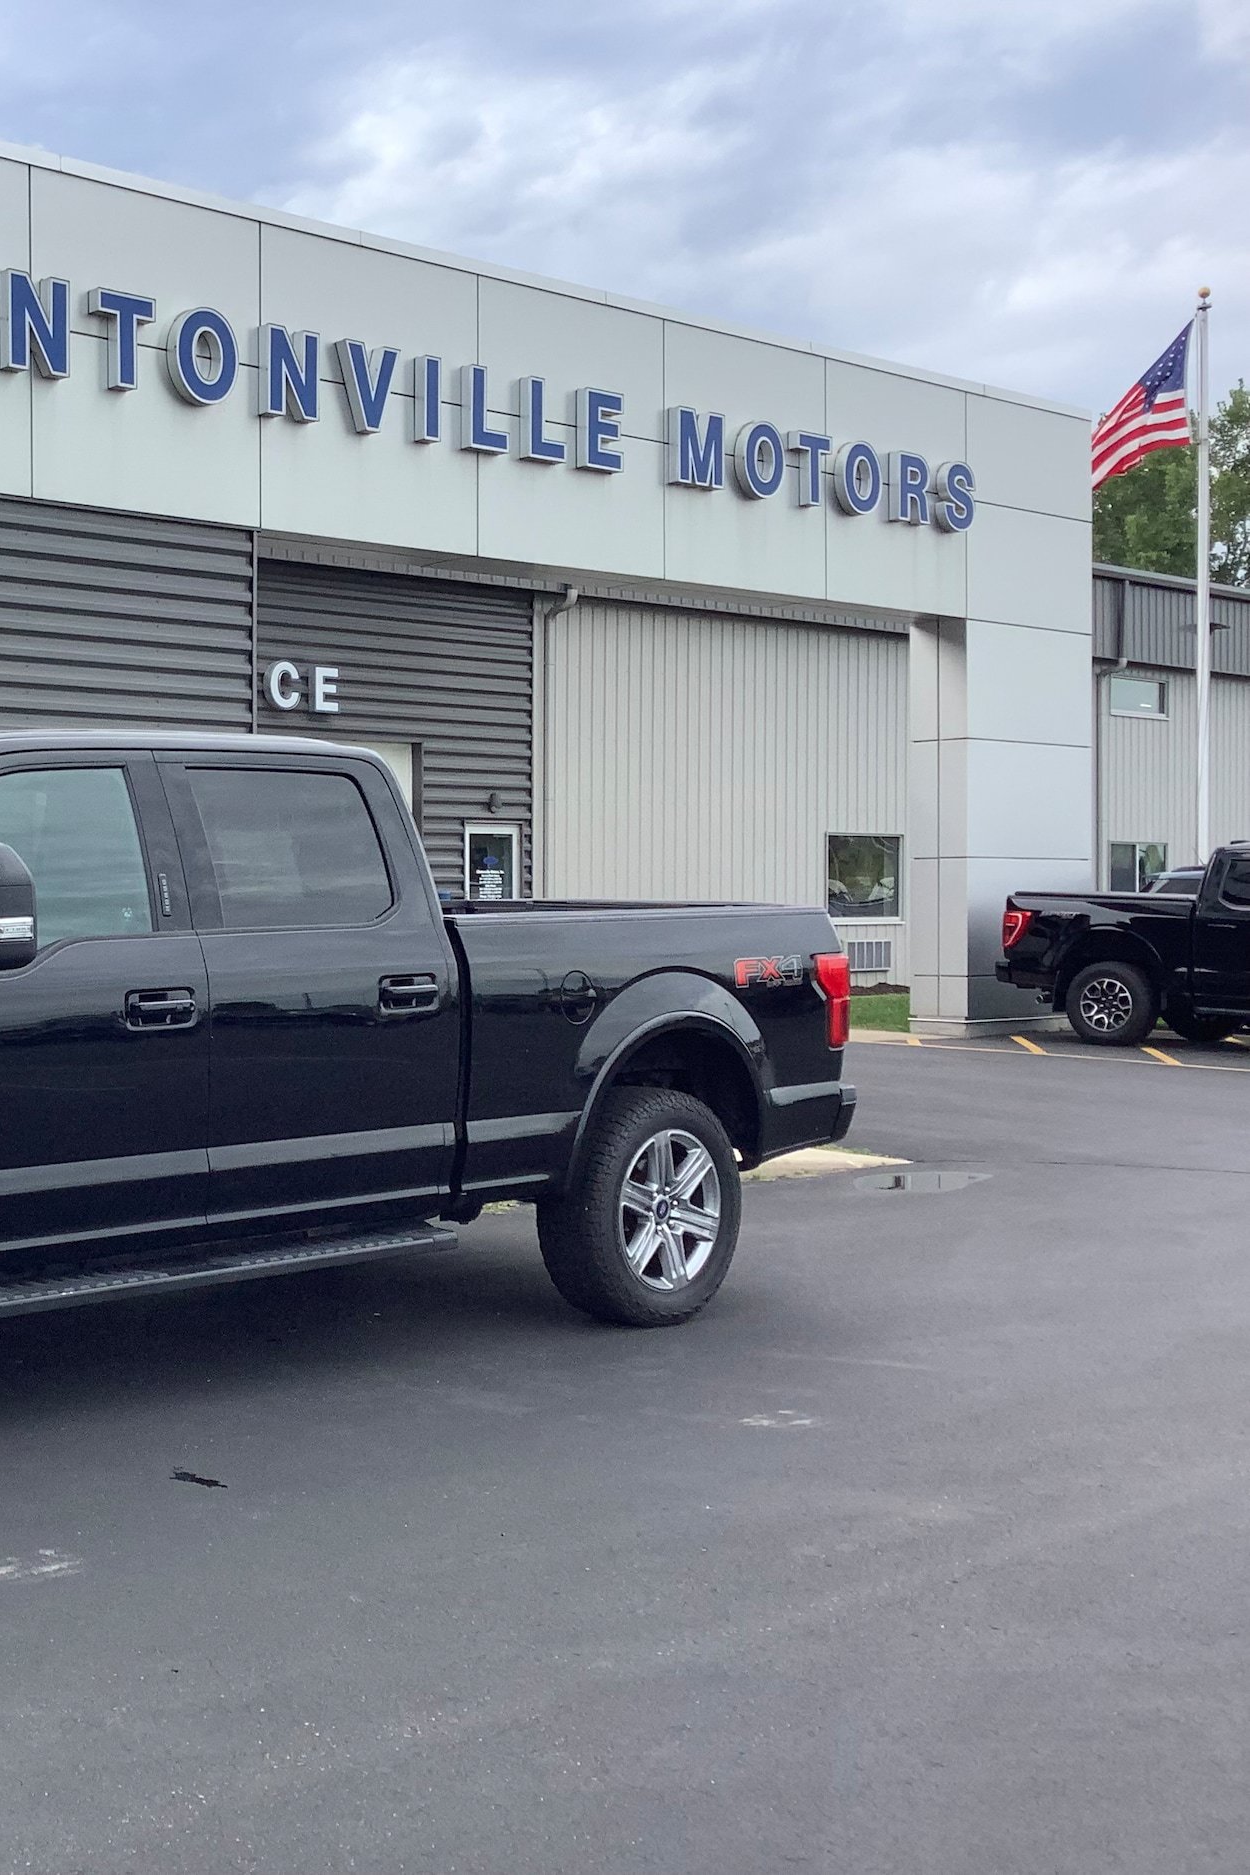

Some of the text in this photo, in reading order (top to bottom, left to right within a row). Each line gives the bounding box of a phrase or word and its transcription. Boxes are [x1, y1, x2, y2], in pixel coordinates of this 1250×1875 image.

[668, 405, 976, 533] MOTORS
[264, 660, 340, 714] CE
[733, 954, 803, 988] FX4
